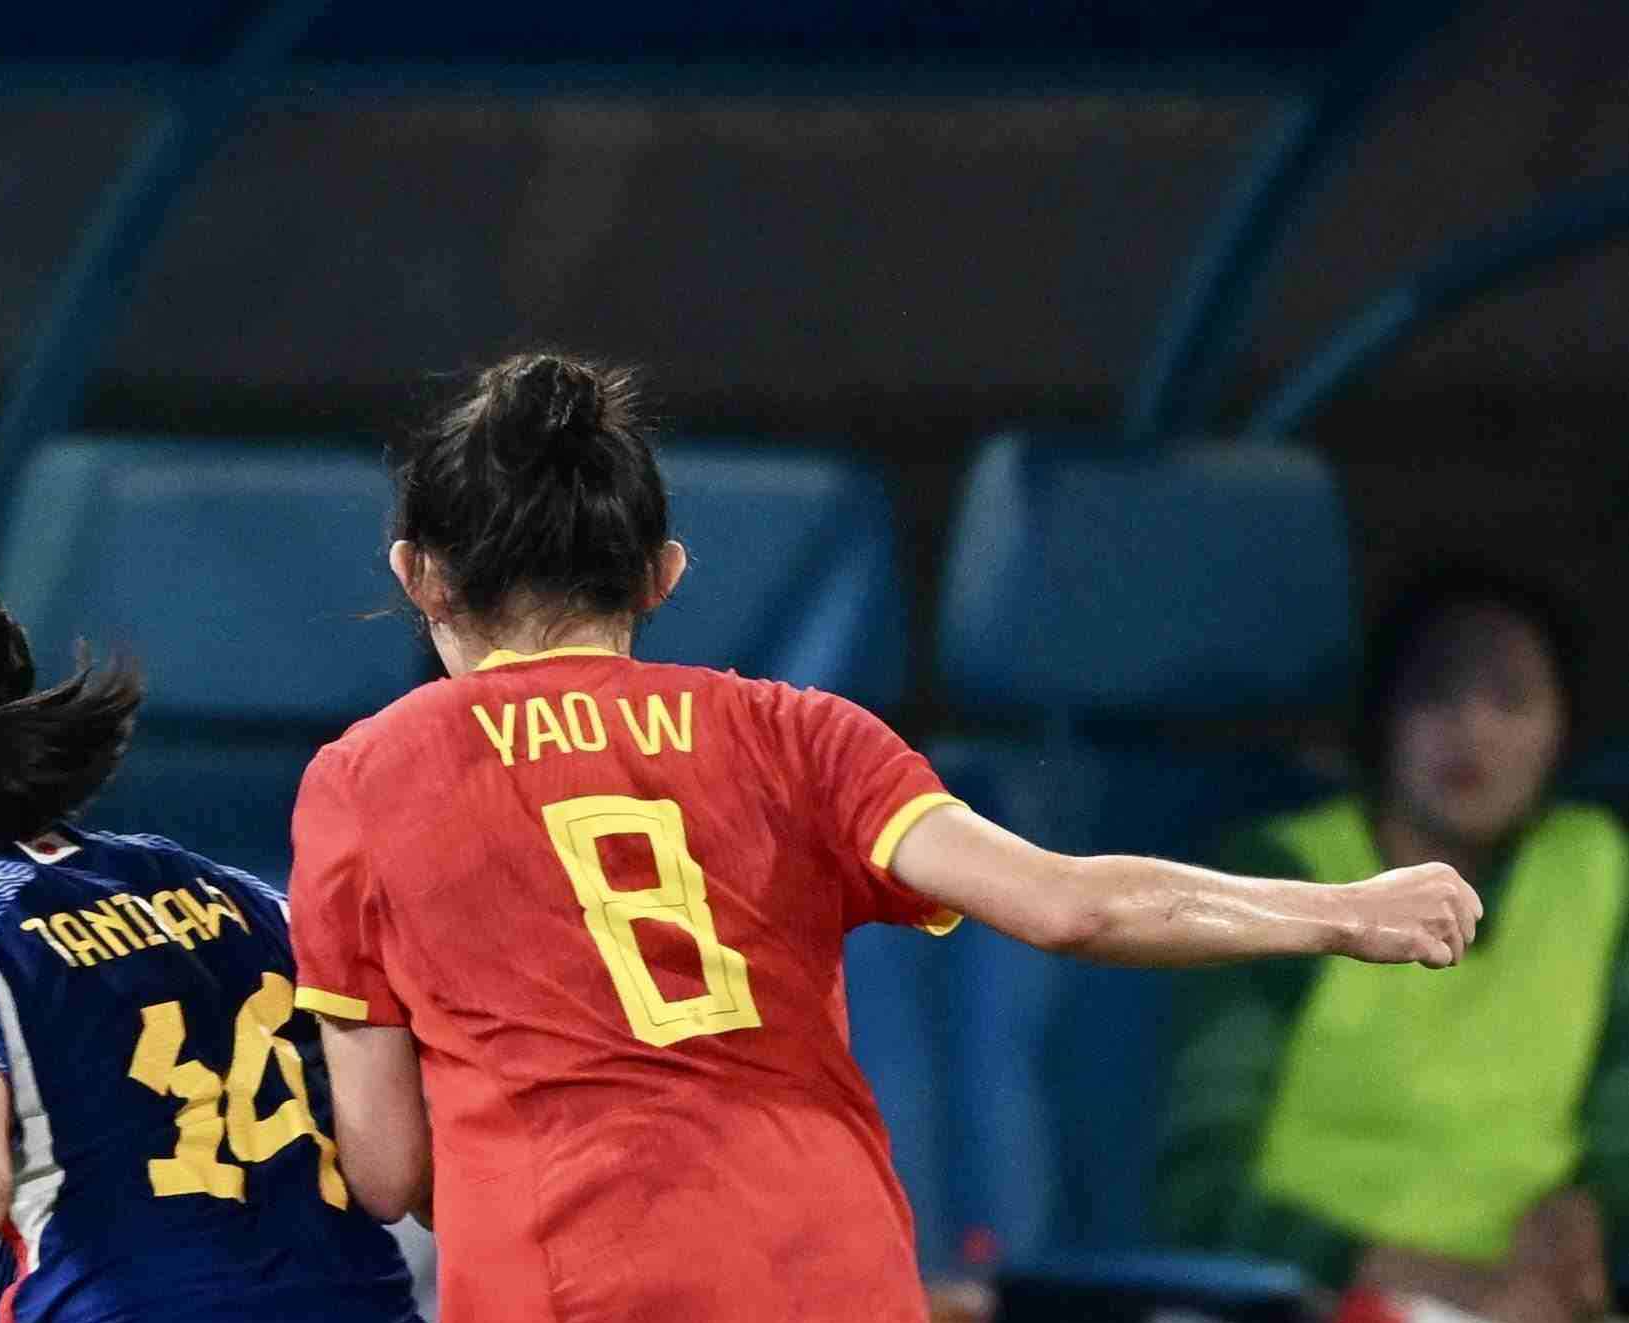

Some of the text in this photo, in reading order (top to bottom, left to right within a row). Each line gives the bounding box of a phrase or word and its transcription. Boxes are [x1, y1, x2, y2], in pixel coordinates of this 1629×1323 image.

[471, 691, 693, 767] YAO W
[541, 794, 763, 1048] 8
[128, 972, 348, 1211] 14
